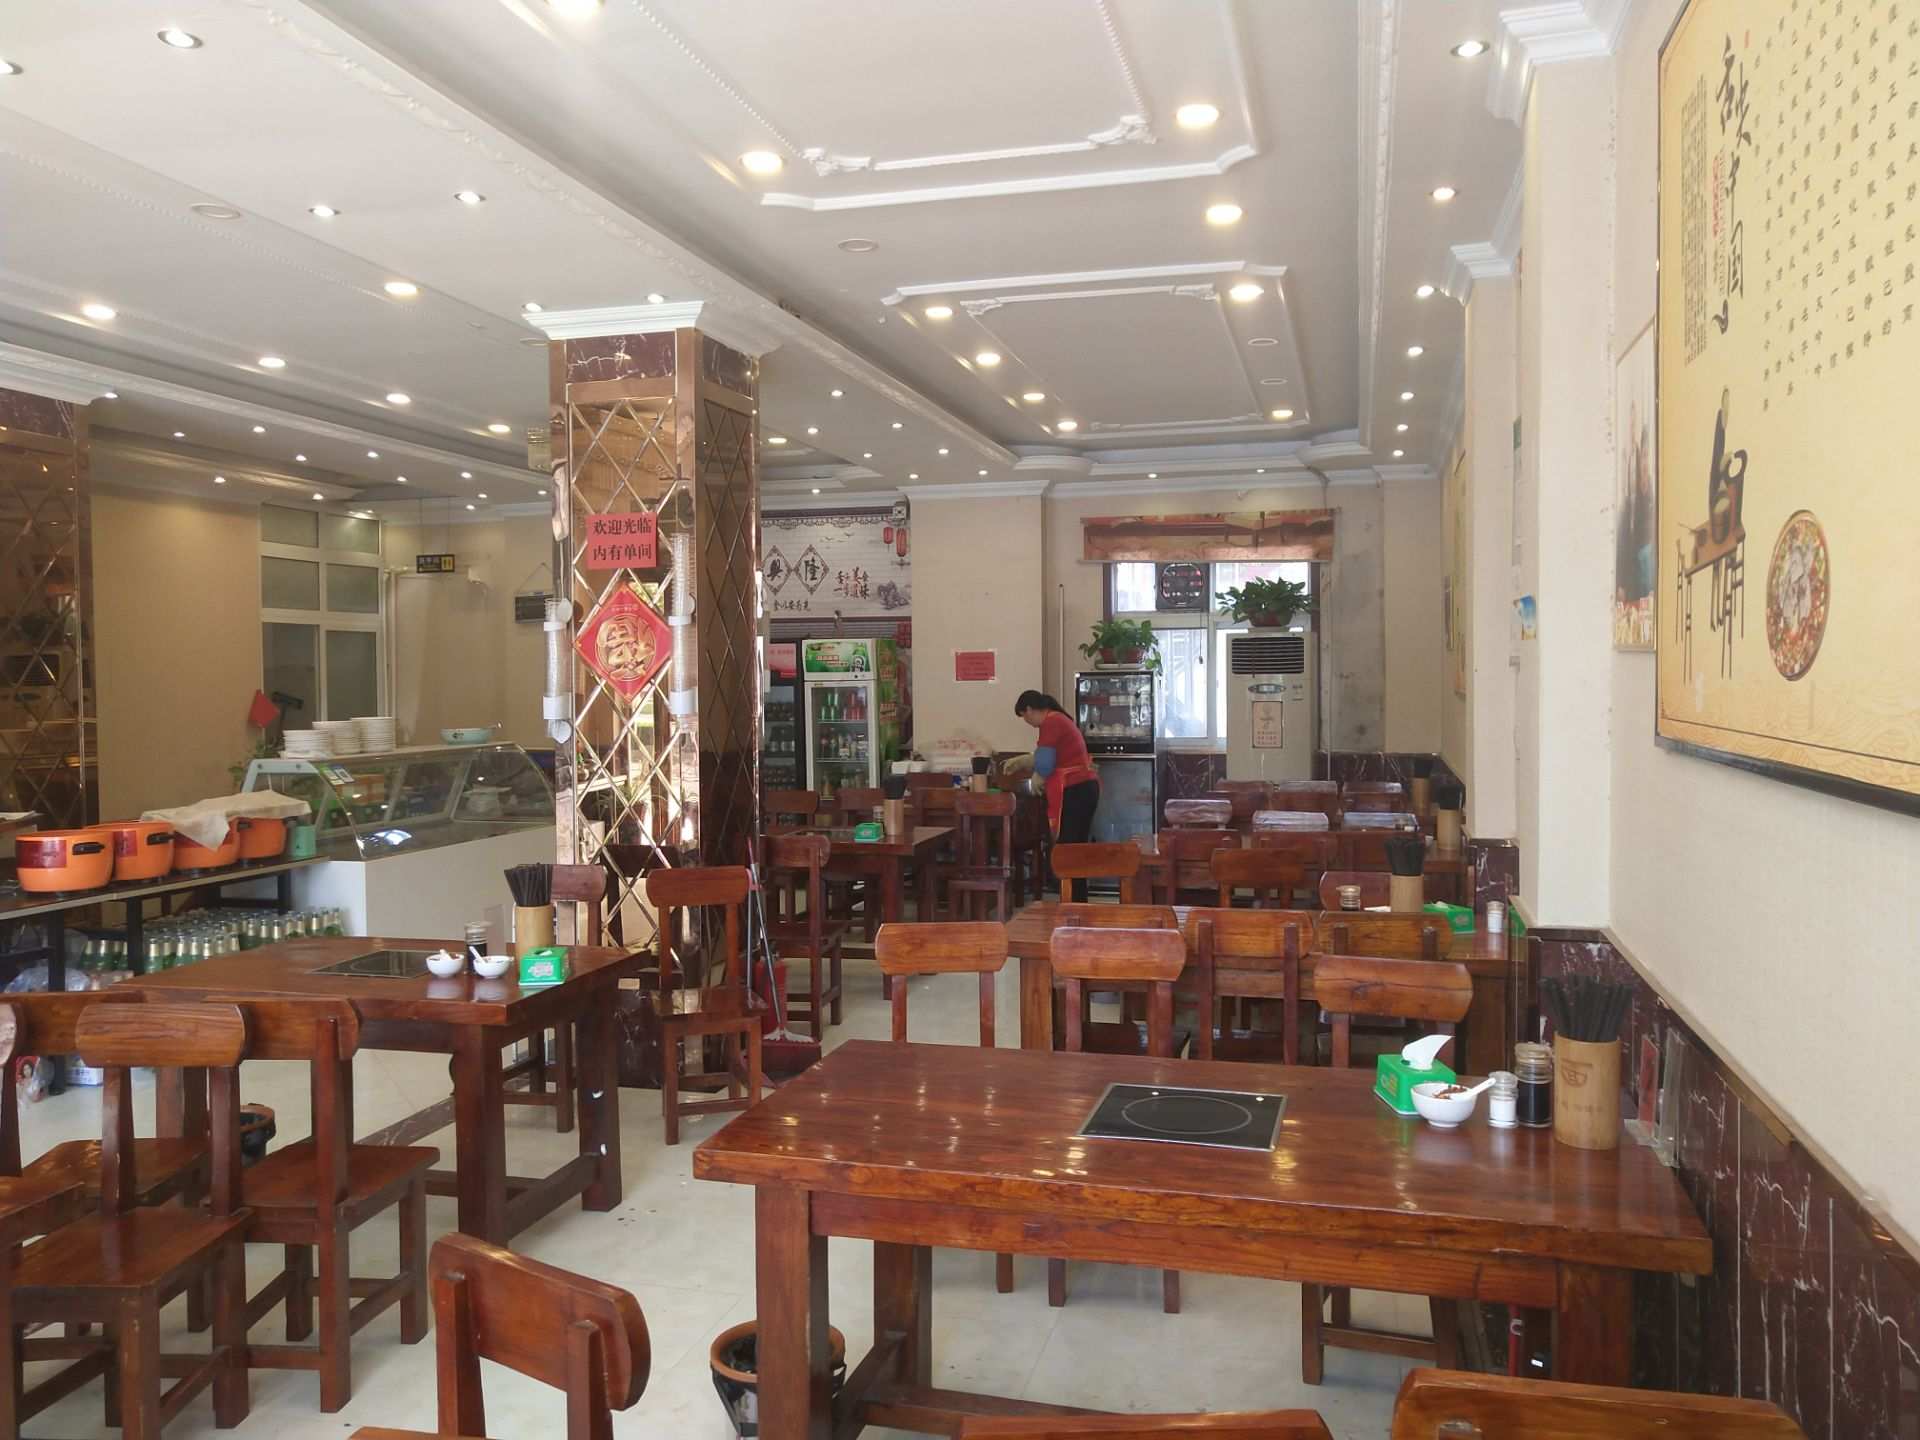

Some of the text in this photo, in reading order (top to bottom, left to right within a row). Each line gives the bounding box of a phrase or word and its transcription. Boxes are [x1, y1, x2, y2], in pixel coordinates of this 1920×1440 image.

[592, 517, 652, 536] 欢迎光临
[593, 543, 652, 561] 内有单间
